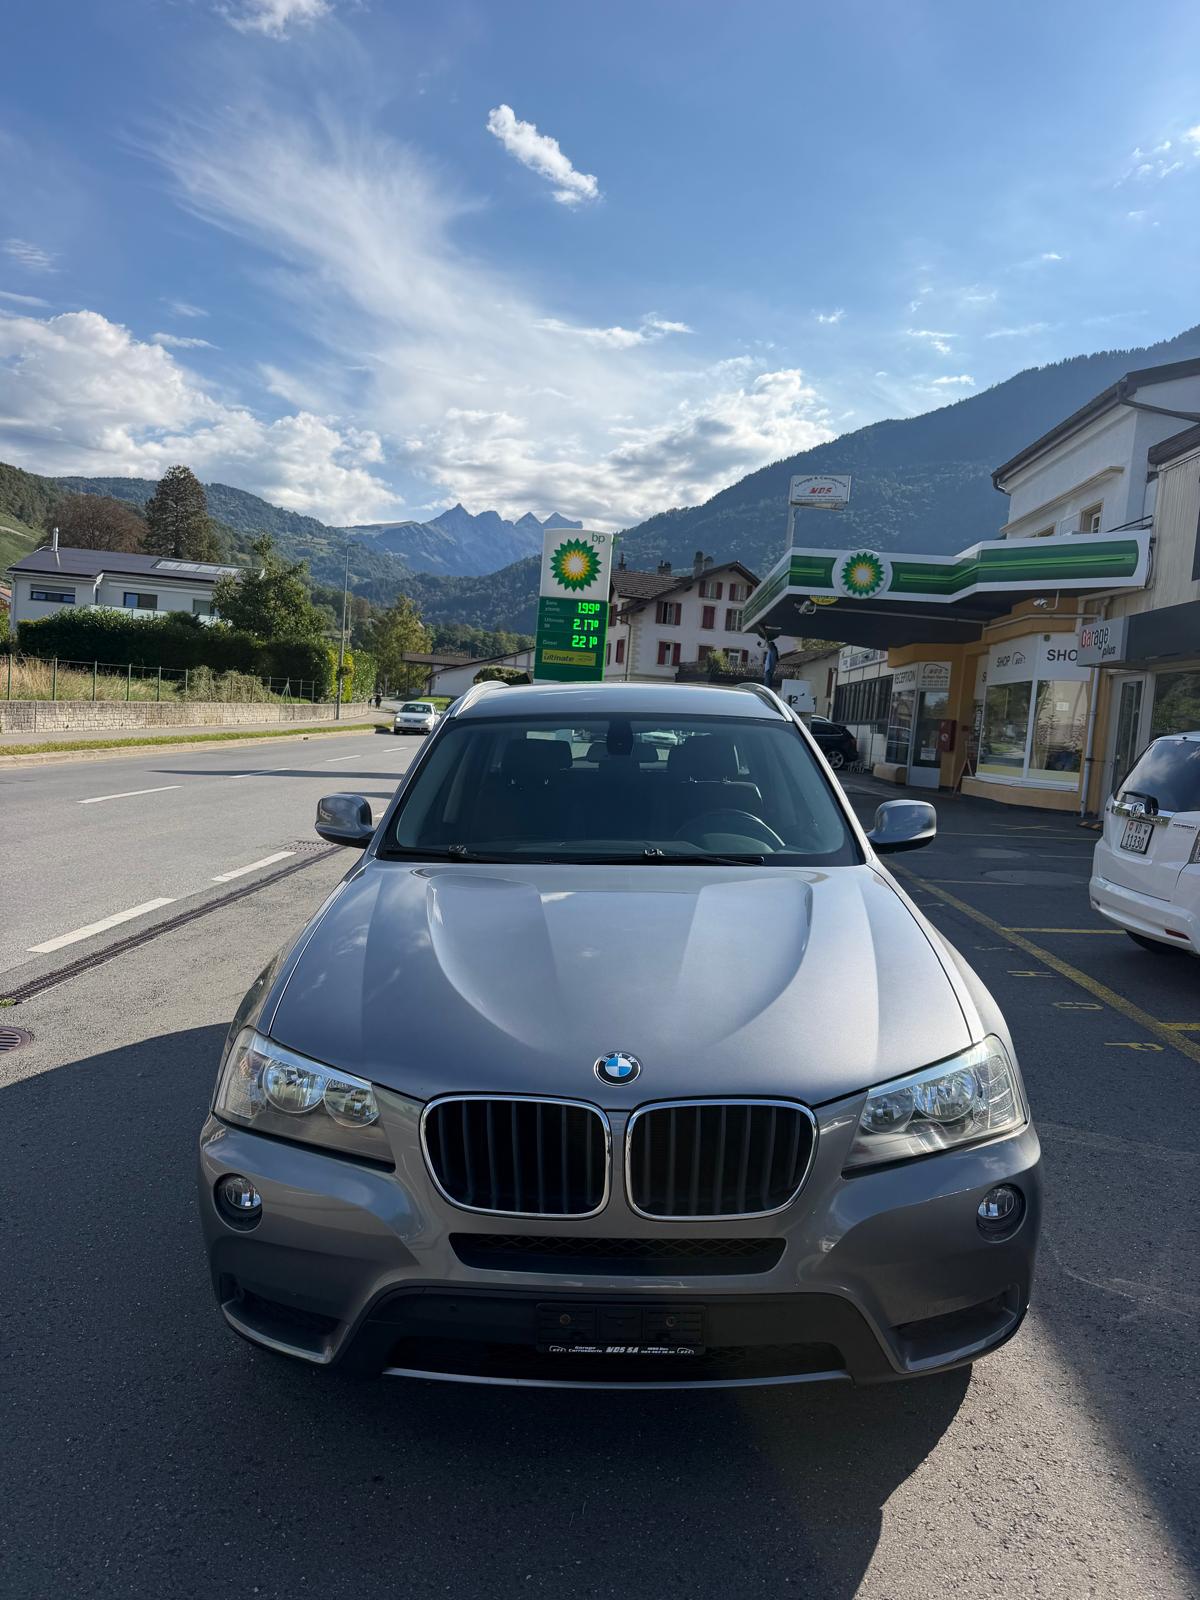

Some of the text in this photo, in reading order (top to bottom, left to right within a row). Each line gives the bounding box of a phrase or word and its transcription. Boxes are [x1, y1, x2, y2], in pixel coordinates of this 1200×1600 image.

[591, 532, 606, 544] bp
[1081, 627, 1109, 650] Garage
[1046, 648, 1078, 662] SHO
[1101, 644, 1116, 659] plus
[996, 655, 1011, 668] SHOP
[600, 1052, 638, 1063] BMW
